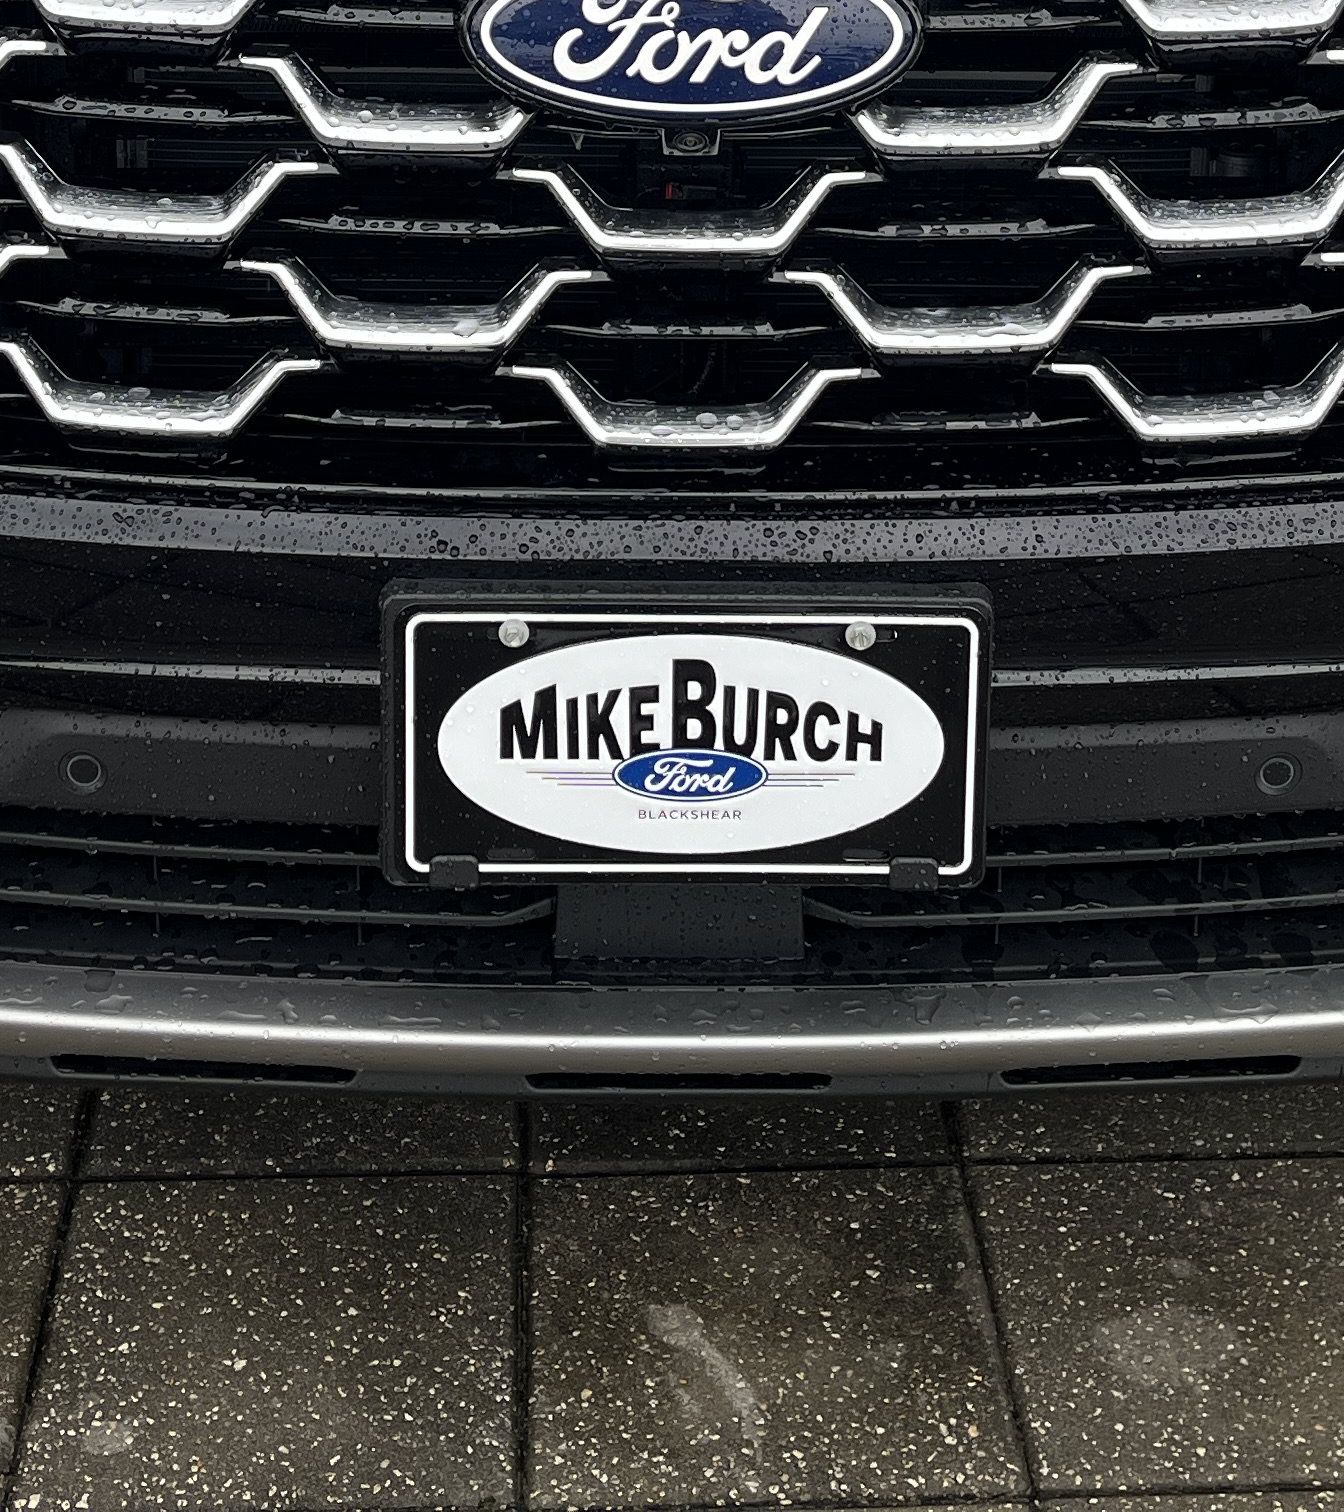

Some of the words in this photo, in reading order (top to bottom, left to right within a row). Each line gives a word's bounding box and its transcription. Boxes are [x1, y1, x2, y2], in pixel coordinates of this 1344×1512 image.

[499, 683, 660, 761] MIKE
[672, 658, 884, 763] BURCH
[643, 756, 736, 794] Ford
[637, 808, 743, 821] BLACKSHEAR
